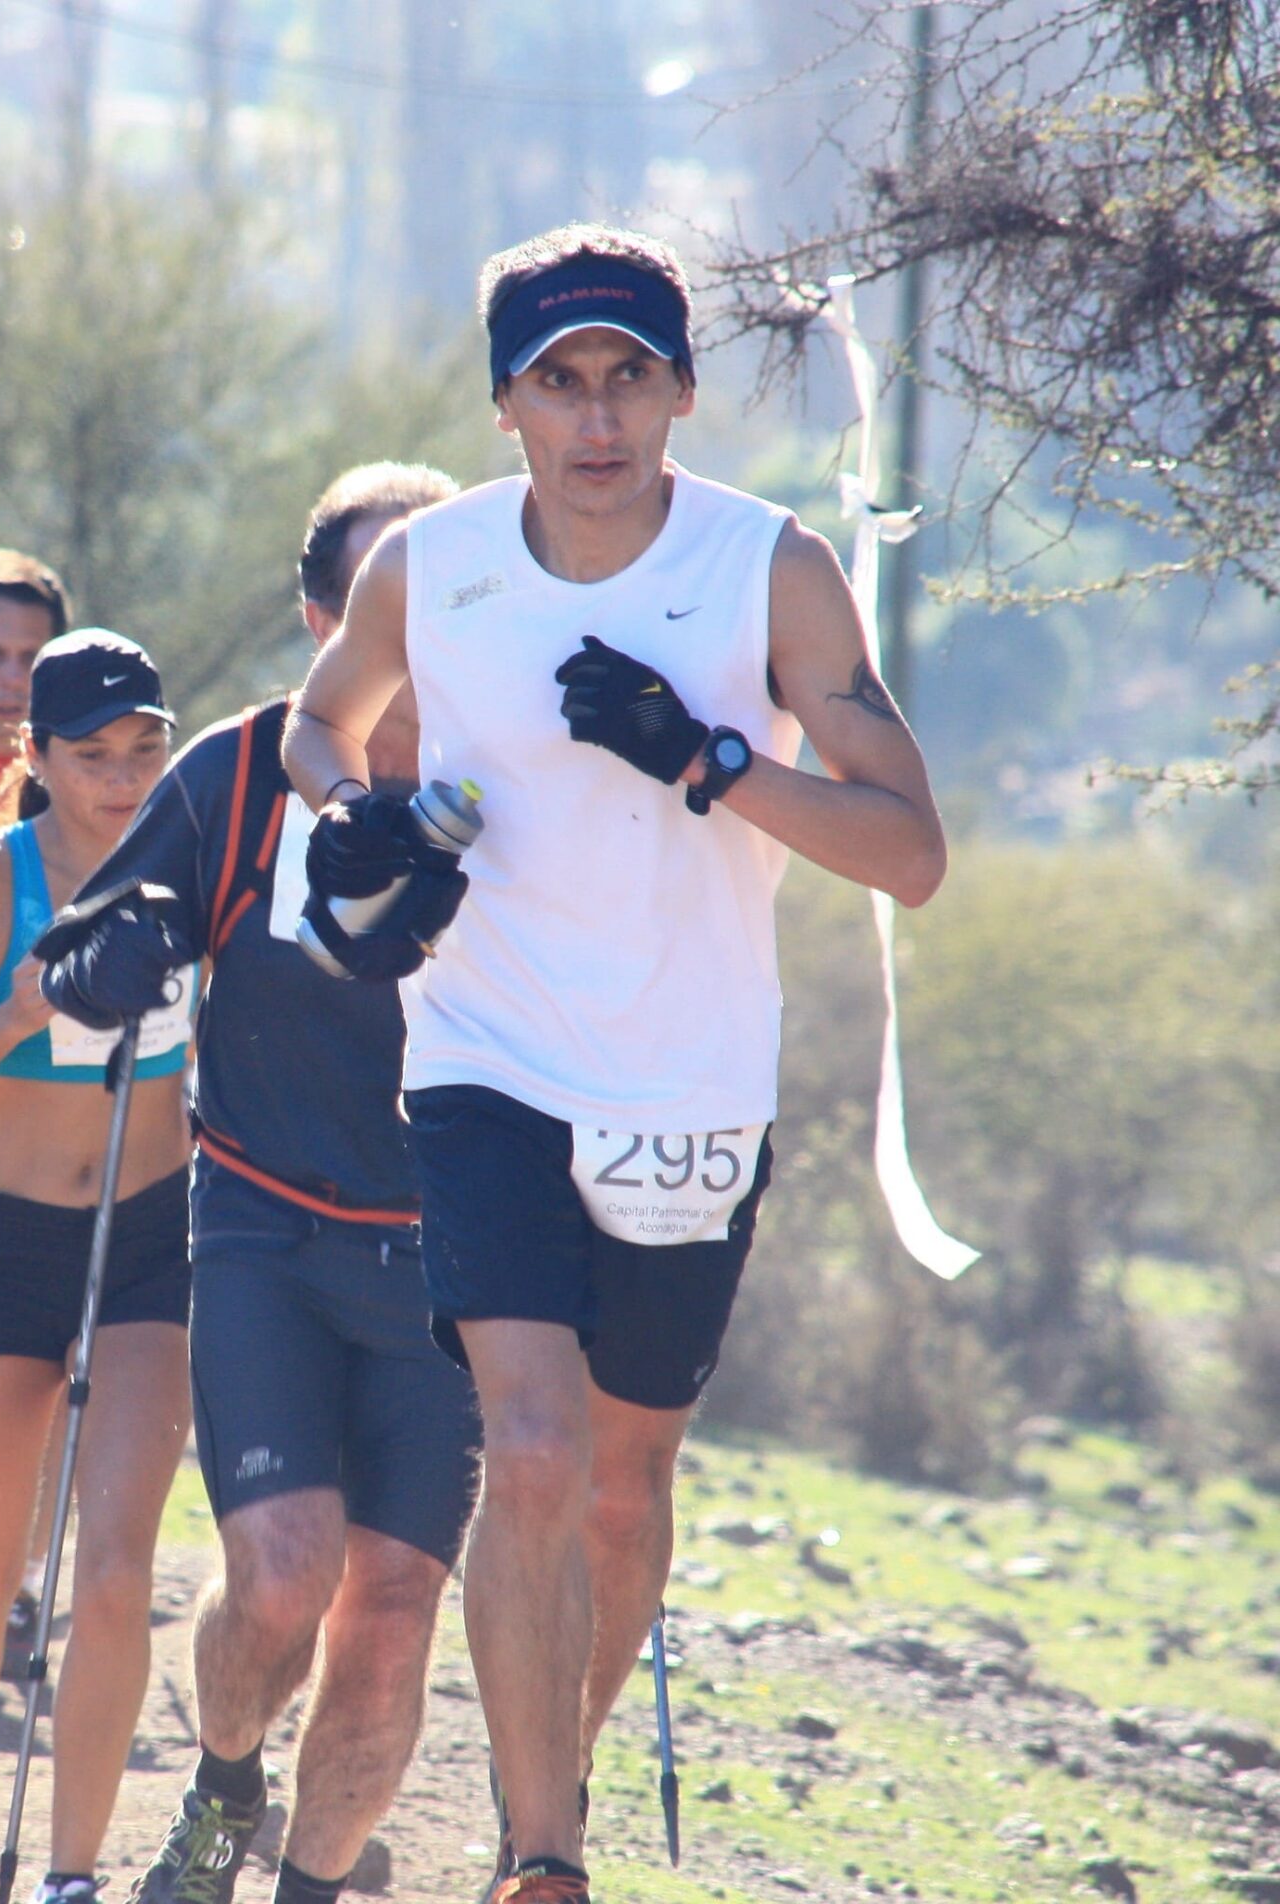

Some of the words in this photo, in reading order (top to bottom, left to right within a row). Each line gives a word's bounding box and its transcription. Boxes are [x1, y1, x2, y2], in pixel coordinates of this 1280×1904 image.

[538, 287, 635, 310] MAMMUT
[593, 1128, 743, 1193] 295
[607, 1202, 648, 1218] Capital
